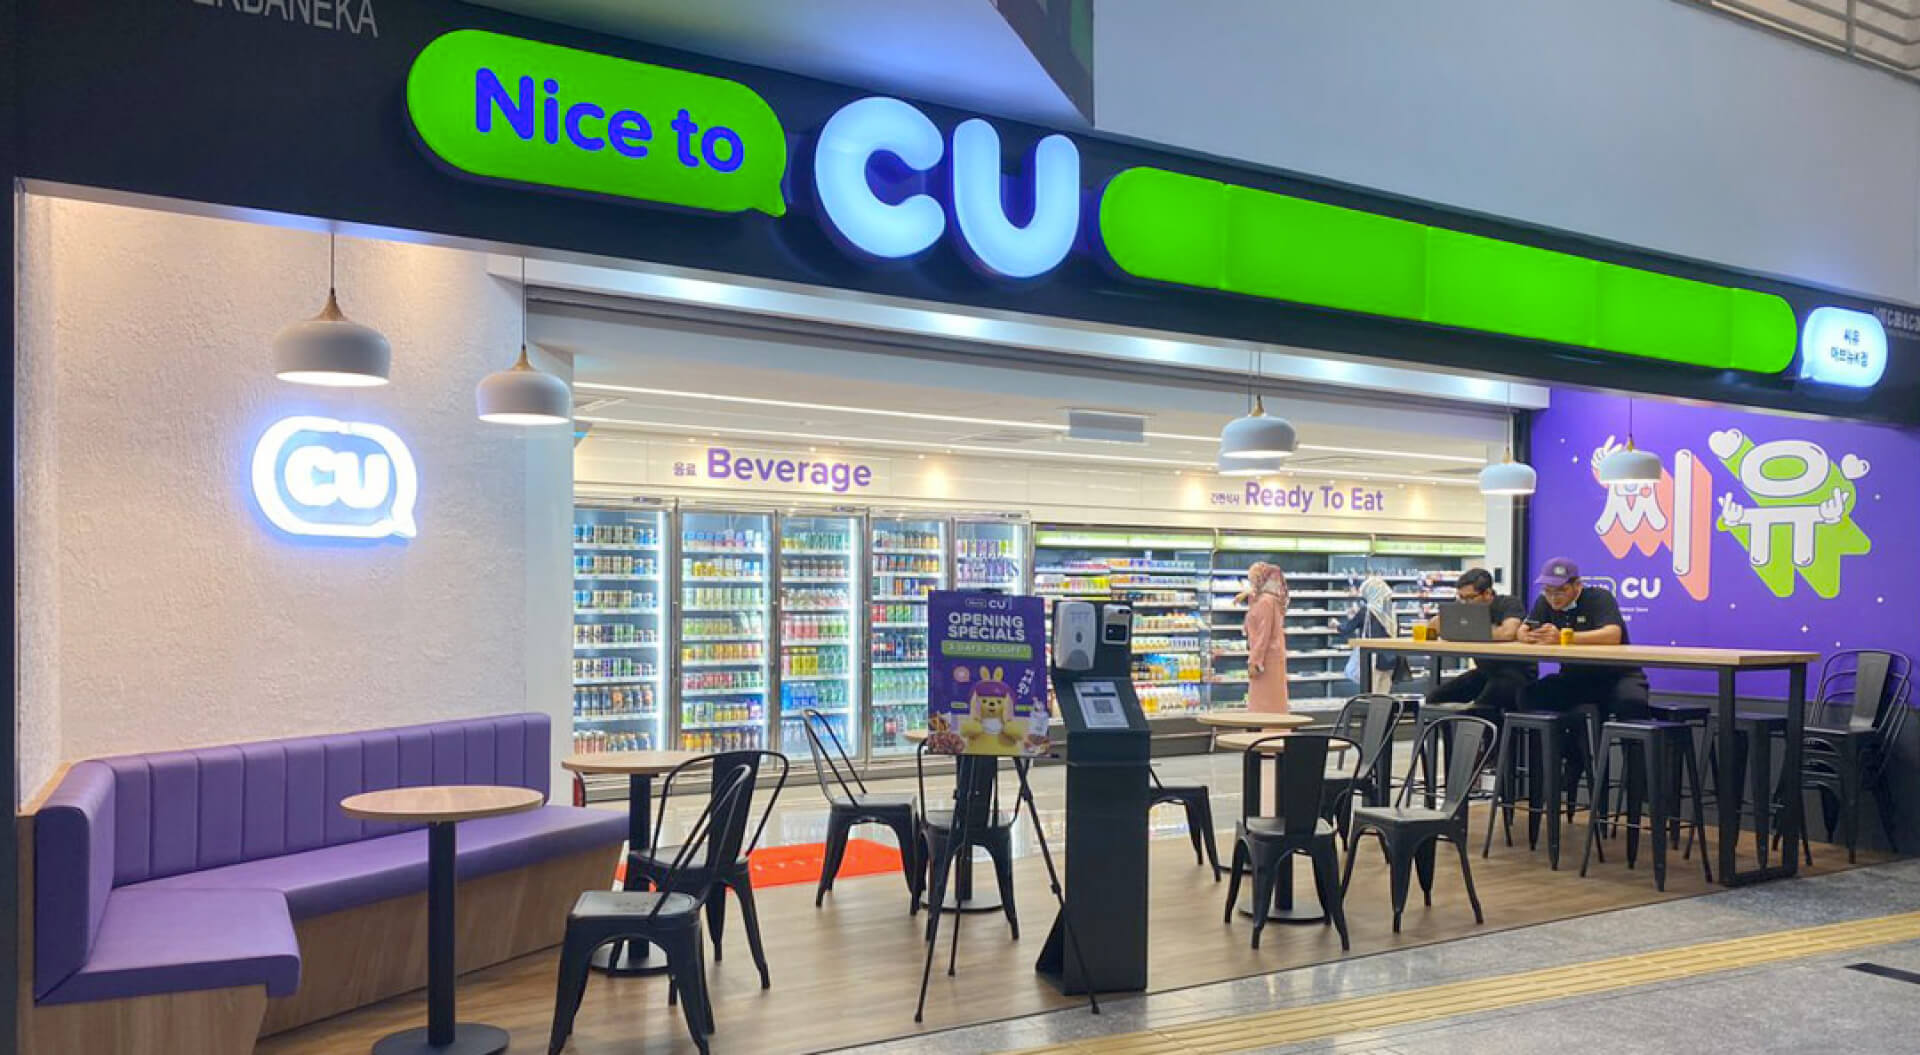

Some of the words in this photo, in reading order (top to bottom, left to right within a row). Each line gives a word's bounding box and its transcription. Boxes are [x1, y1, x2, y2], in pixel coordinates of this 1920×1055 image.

[473, 67, 653, 158] Nice
[671, 109, 744, 173] to
[814, 96, 1080, 278] CU
[285, 445, 390, 509] CU
[707, 448, 872, 492] Beverage
[1245, 481, 1314, 512] Ready
[1320, 485, 1344, 509] To
[1351, 487, 1384, 511] Eat
[1621, 577, 1661, 599] CU
[988, 600, 1006, 609] CU
[948, 612, 1024, 629] OPENING
[948, 625, 1025, 641] SPECIALS
